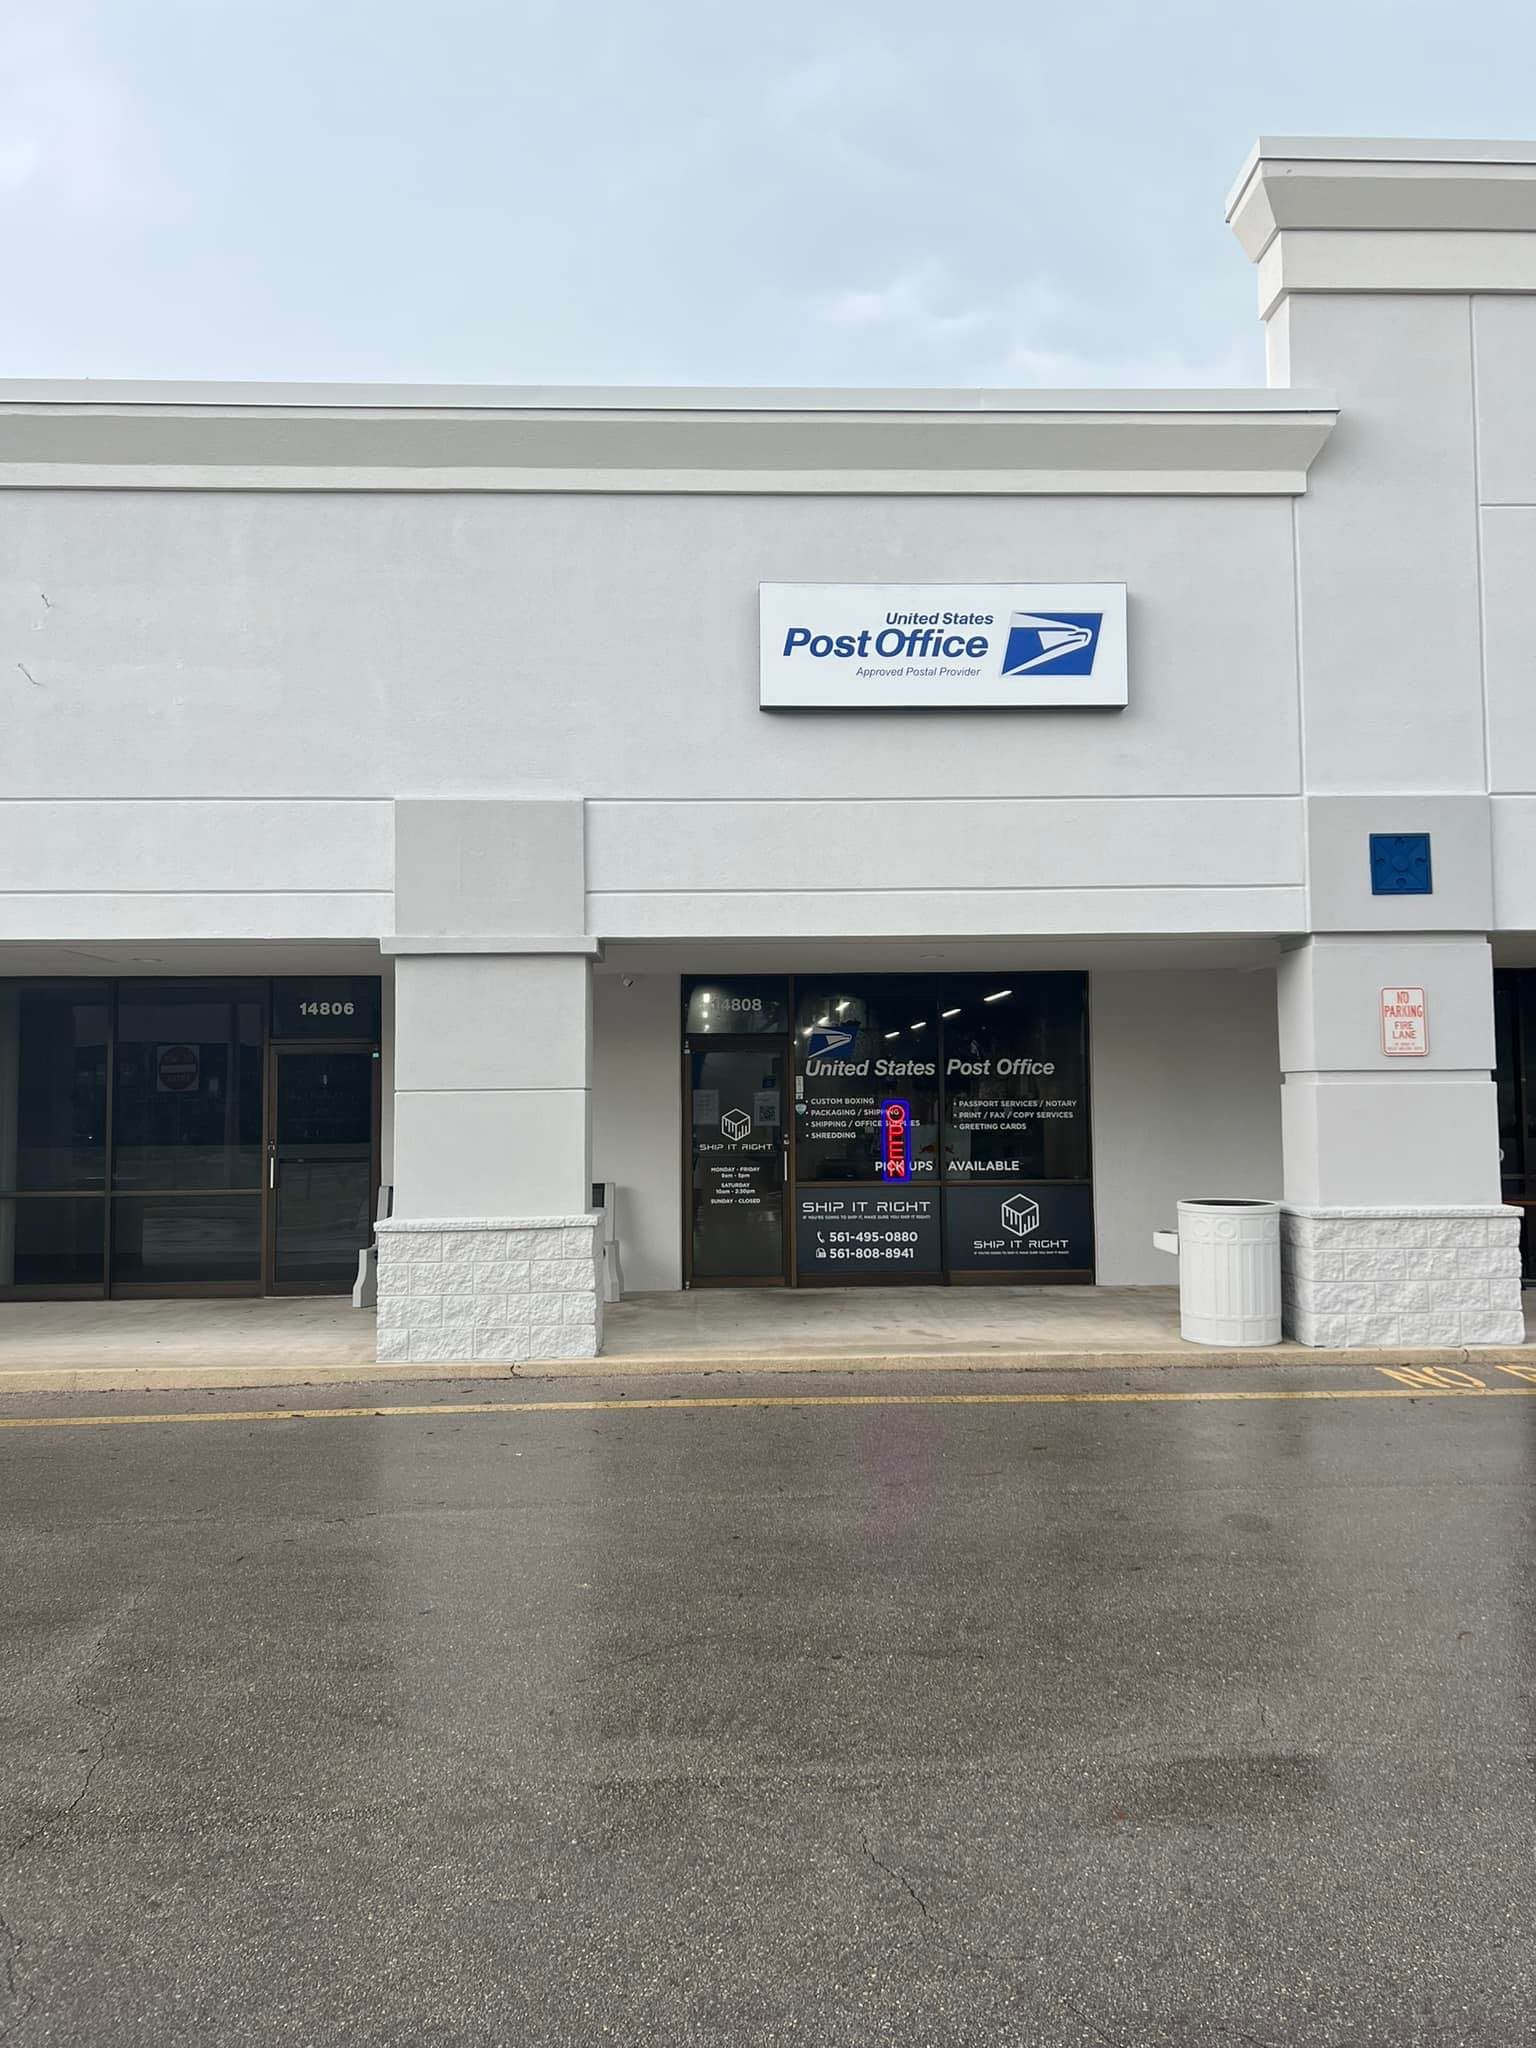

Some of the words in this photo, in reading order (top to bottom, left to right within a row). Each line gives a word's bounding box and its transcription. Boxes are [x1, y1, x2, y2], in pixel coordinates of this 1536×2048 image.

[886, 612, 939, 625] United
[942, 612, 994, 625] States
[783, 628, 872, 658] Post
[875, 628, 989, 658] Office
[856, 667, 903, 678] Approved
[906, 667, 937, 677] Postal
[939, 667, 981, 677] Provider
[1396, 991, 1409, 1004] NO
[299, 1002, 355, 1015] 14806
[1384, 1005, 1423, 1017] PARKING
[1394, 1021, 1414, 1030] FIRE
[1392, 1030, 1417, 1039] LANE
[805, 1060, 869, 1076] United
[874, 1059, 936, 1076] States
[946, 1058, 991, 1075] Post
[996, 1058, 1055, 1075] Office
[886, 1104, 906, 1177] OPEN
[909, 1161, 933, 1171] UPS
[948, 1160, 1020, 1171] AVAILABLE
[802, 1201, 845, 1213] SHIP
[852, 1201, 869, 1213] IT
[876, 1201, 931, 1213] RIGHT
[829, 1231, 918, 1242] 561-495-0880
[973, 1240, 1005, 1249] SHIP
[1010, 1240, 1023, 1249] IT
[1028, 1240, 1069, 1249] RIGHT
[829, 1248, 914, 1259] 561-808-8941
[1374, 1366, 1486, 1389] NO
